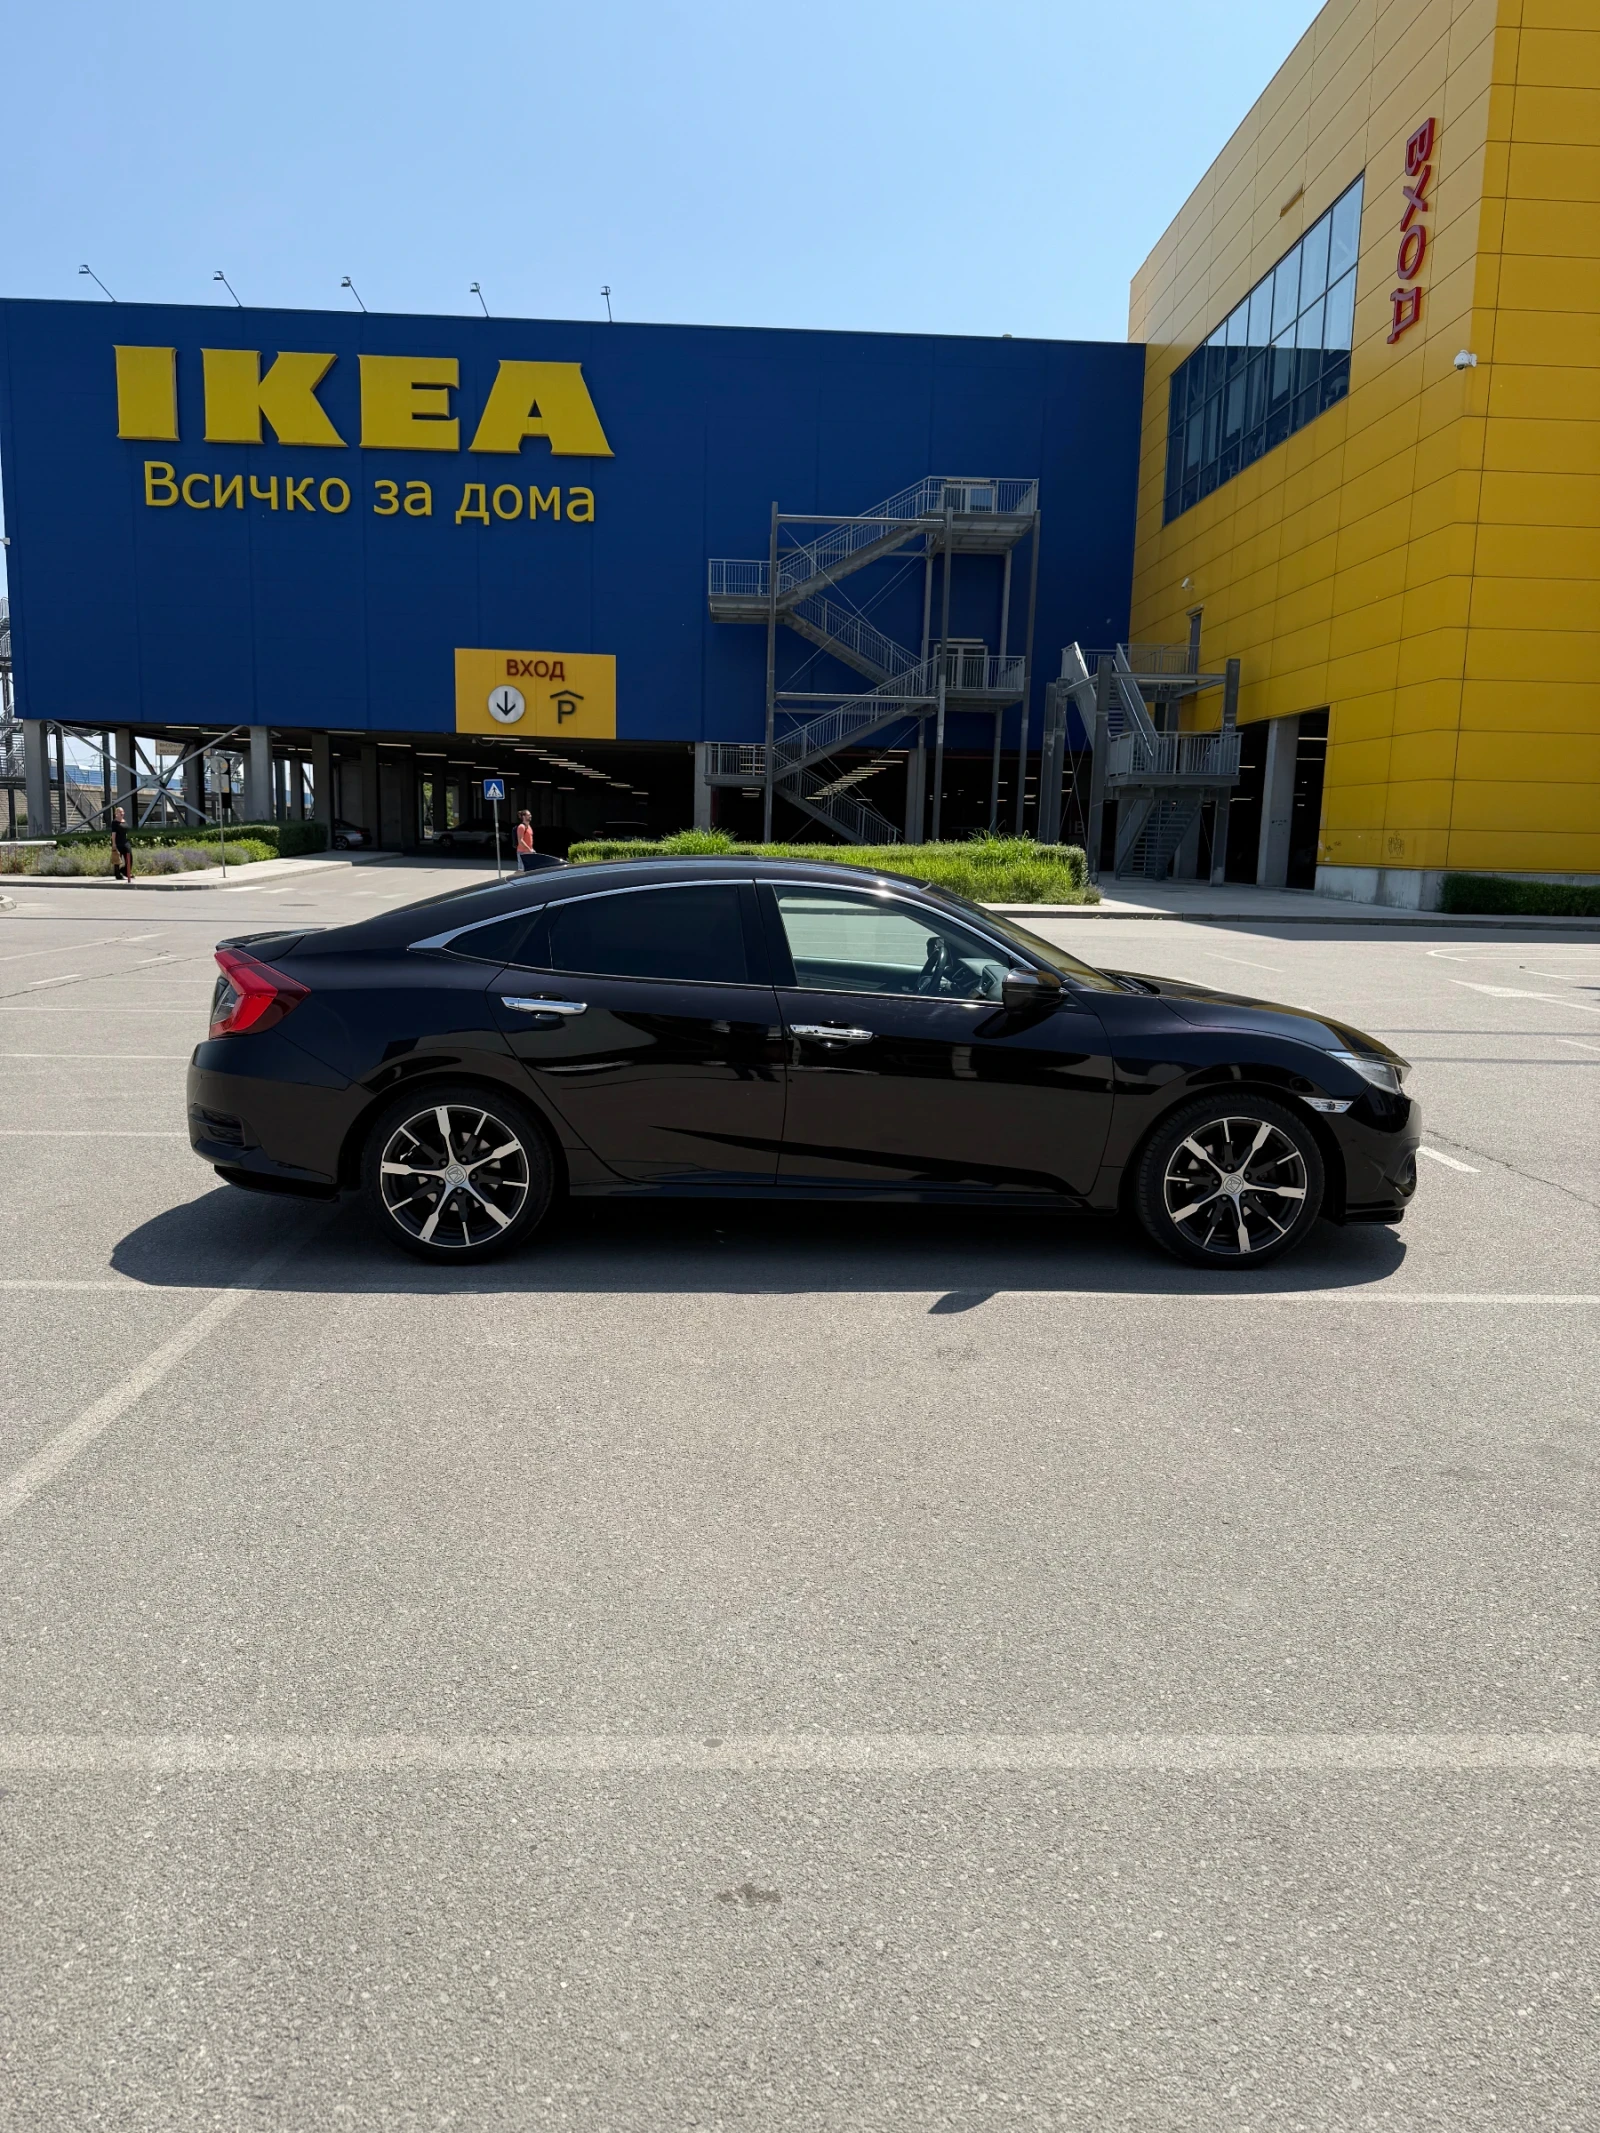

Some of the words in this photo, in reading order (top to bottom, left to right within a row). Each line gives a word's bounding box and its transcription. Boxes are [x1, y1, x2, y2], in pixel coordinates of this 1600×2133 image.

[1387, 117, 1436, 344] ВХОД
[113, 345, 615, 457] IKEA
[144, 461, 351, 514] Всичко
[373, 479, 433, 516] за
[455, 483, 595, 525] дома
[506, 659, 565, 681] ВХОД
[557, 700, 576, 724] P
